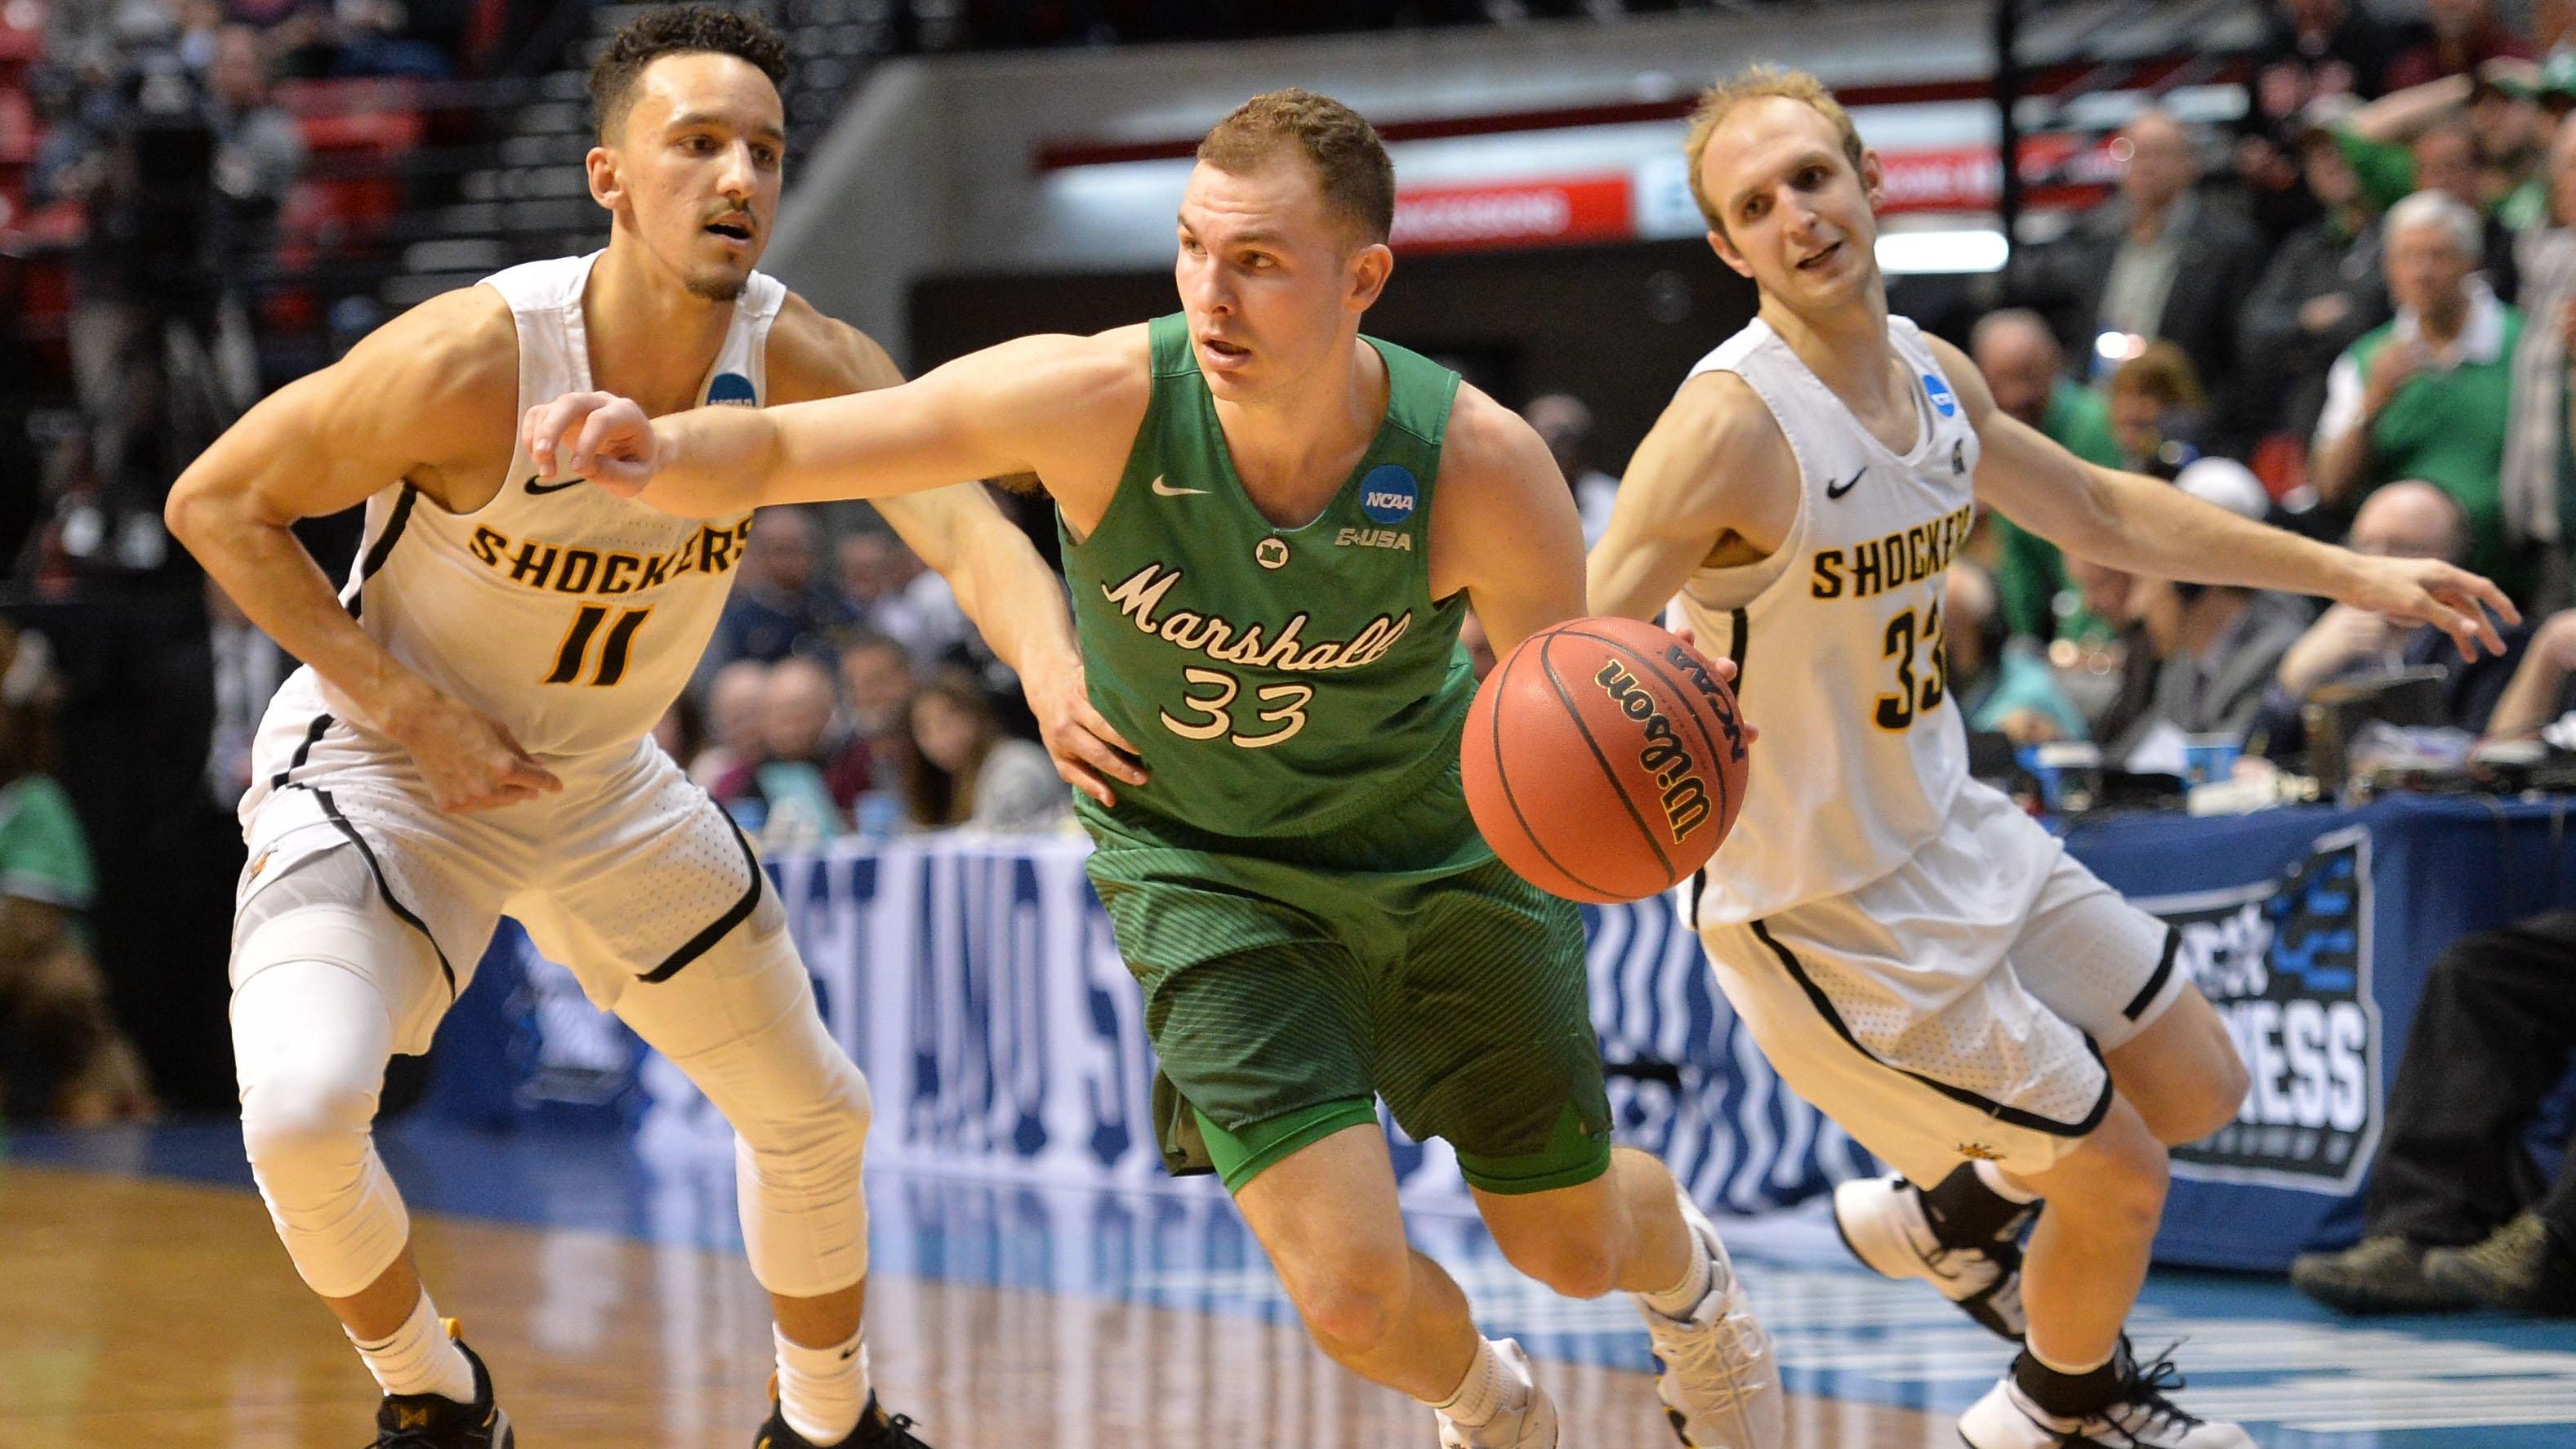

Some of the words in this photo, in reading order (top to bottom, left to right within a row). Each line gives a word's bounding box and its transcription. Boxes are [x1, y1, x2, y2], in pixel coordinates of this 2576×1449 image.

[1366, 491, 1414, 510] NCAA
[537, 601, 655, 687] 11
[1099, 561, 1412, 673] Marshall
[1159, 665, 1317, 749] 33
[1594, 658, 1712, 845] Wilson
[1667, 643, 1745, 765] NCAA
